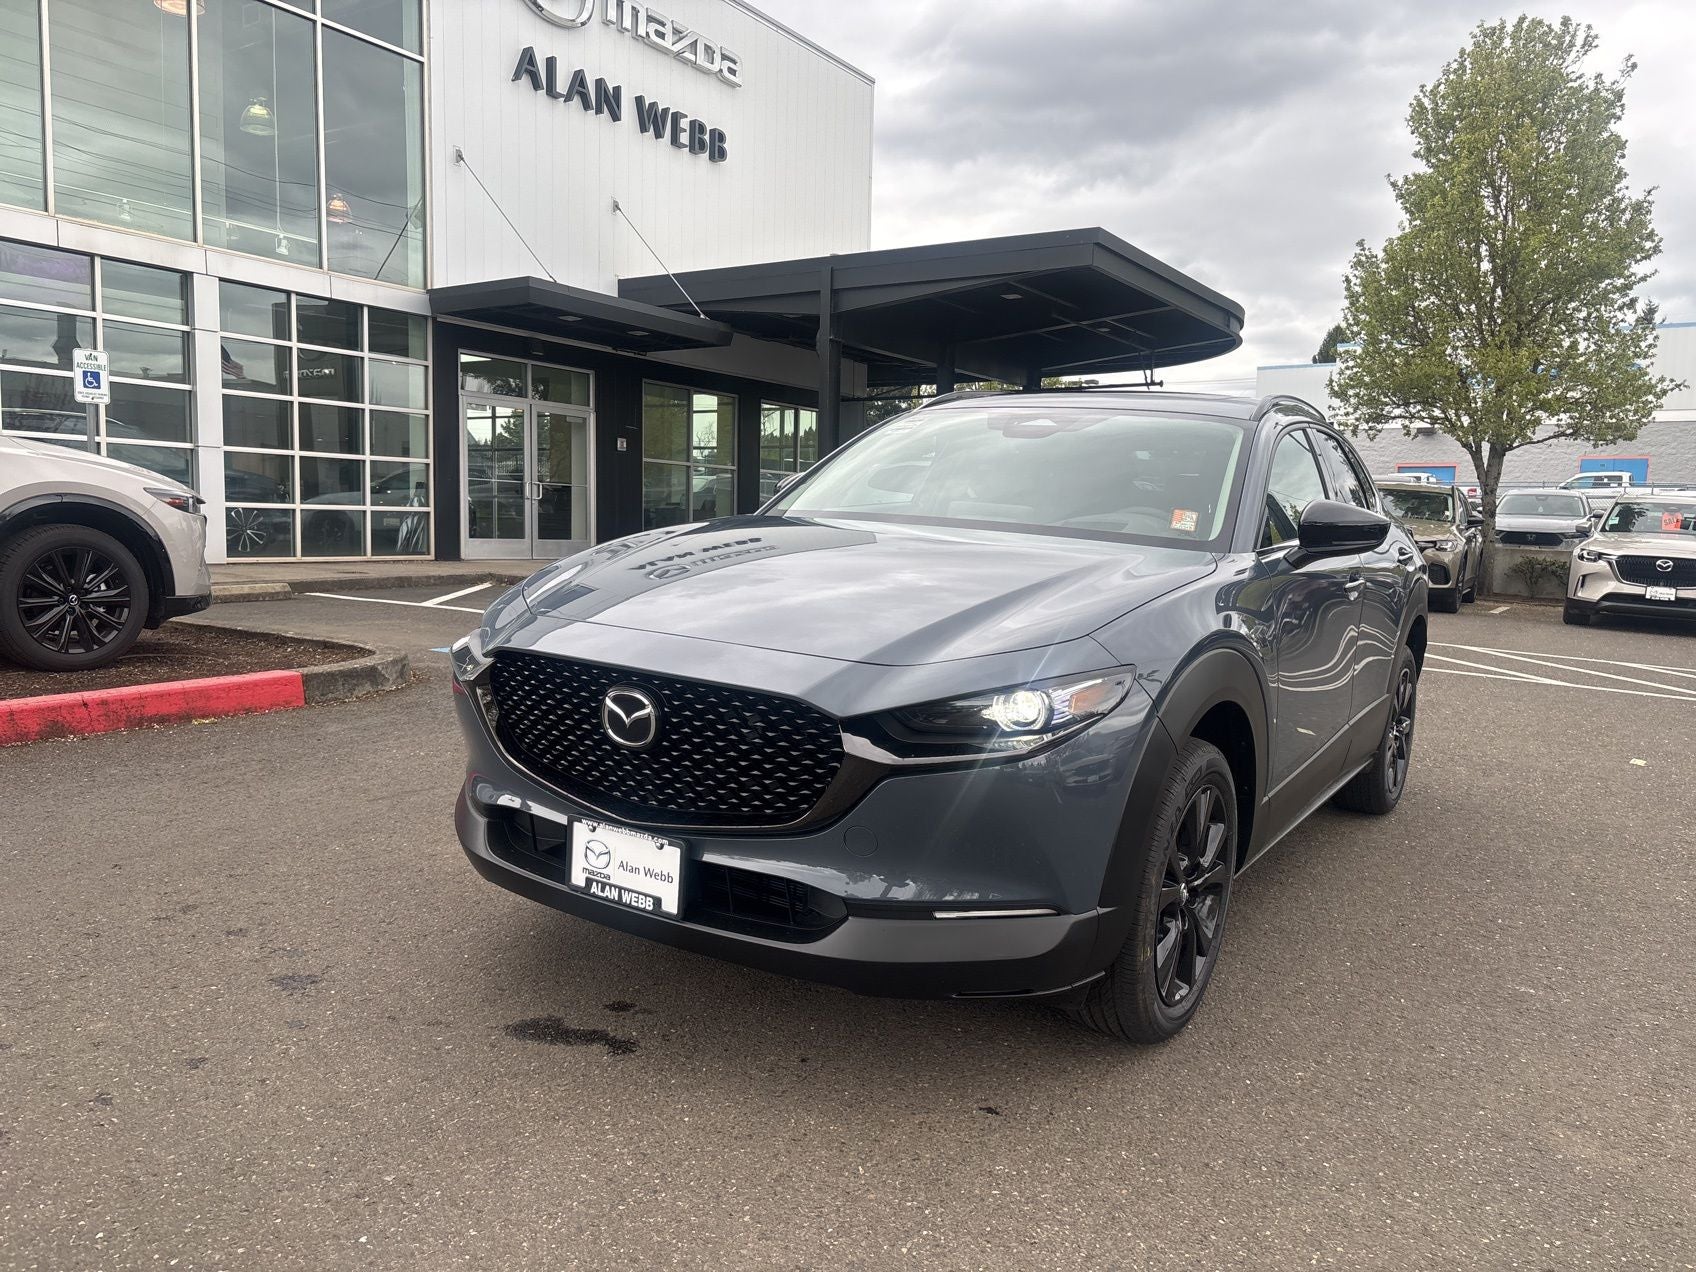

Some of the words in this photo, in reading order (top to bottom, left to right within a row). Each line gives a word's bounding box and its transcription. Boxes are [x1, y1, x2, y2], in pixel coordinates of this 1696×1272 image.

[511, 46, 622, 122] ALAN
[634, 95, 728, 163] WEBB
[76, 362, 107, 371] ACCESSIBLE
[84, 353, 98, 362] VAN
[581, 818, 669, 846] www.alanwebbmazda.com
[617, 860, 640, 875] Alan
[643, 866, 674, 884] Webb
[590, 881, 619, 901] ALAN
[621, 889, 654, 910] WEBB
